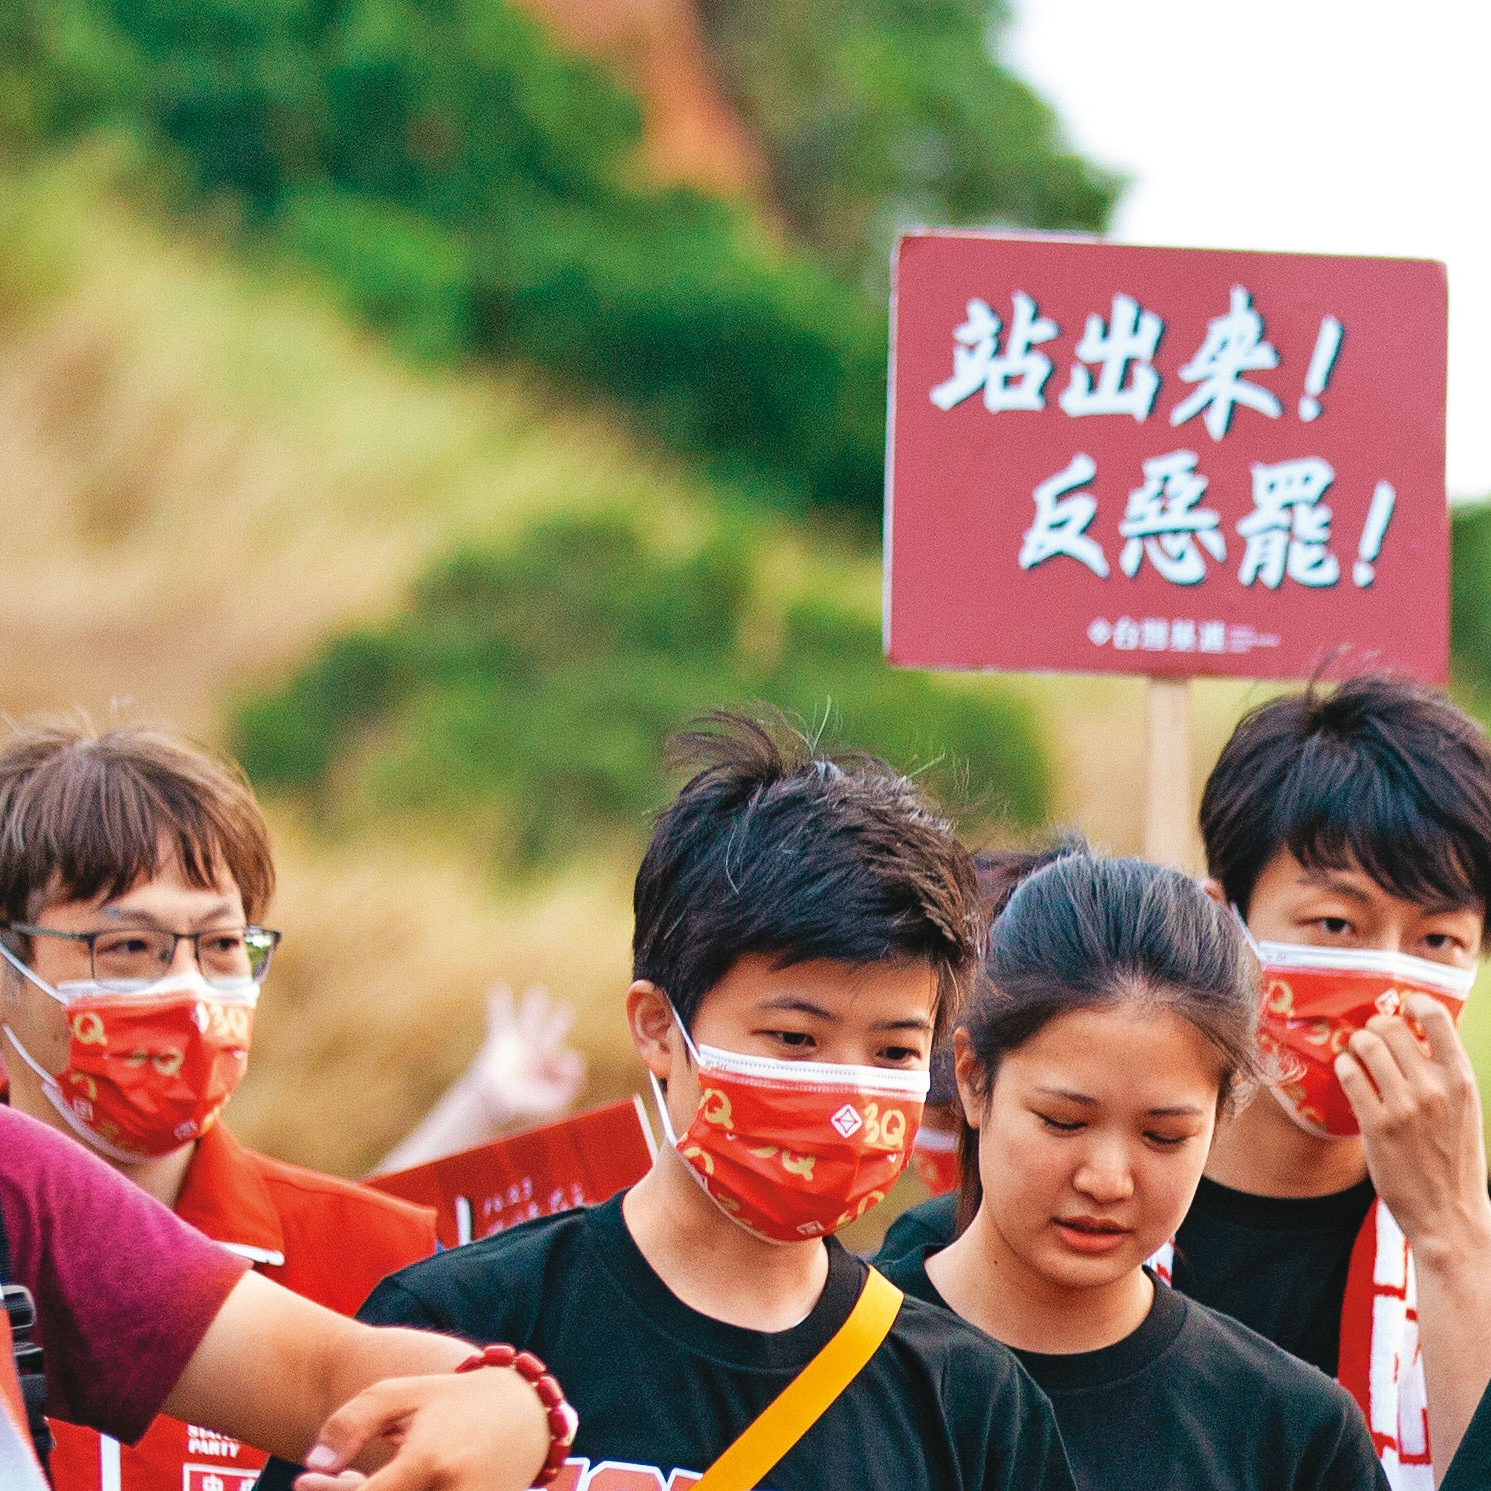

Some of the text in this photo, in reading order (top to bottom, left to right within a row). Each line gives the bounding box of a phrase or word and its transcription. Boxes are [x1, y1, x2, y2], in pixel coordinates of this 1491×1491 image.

[1019, 449, 1396, 589] 反惡罷!
[863, 1102, 906, 1148] 3Q
[188, 1438, 240, 1458] PARTY
